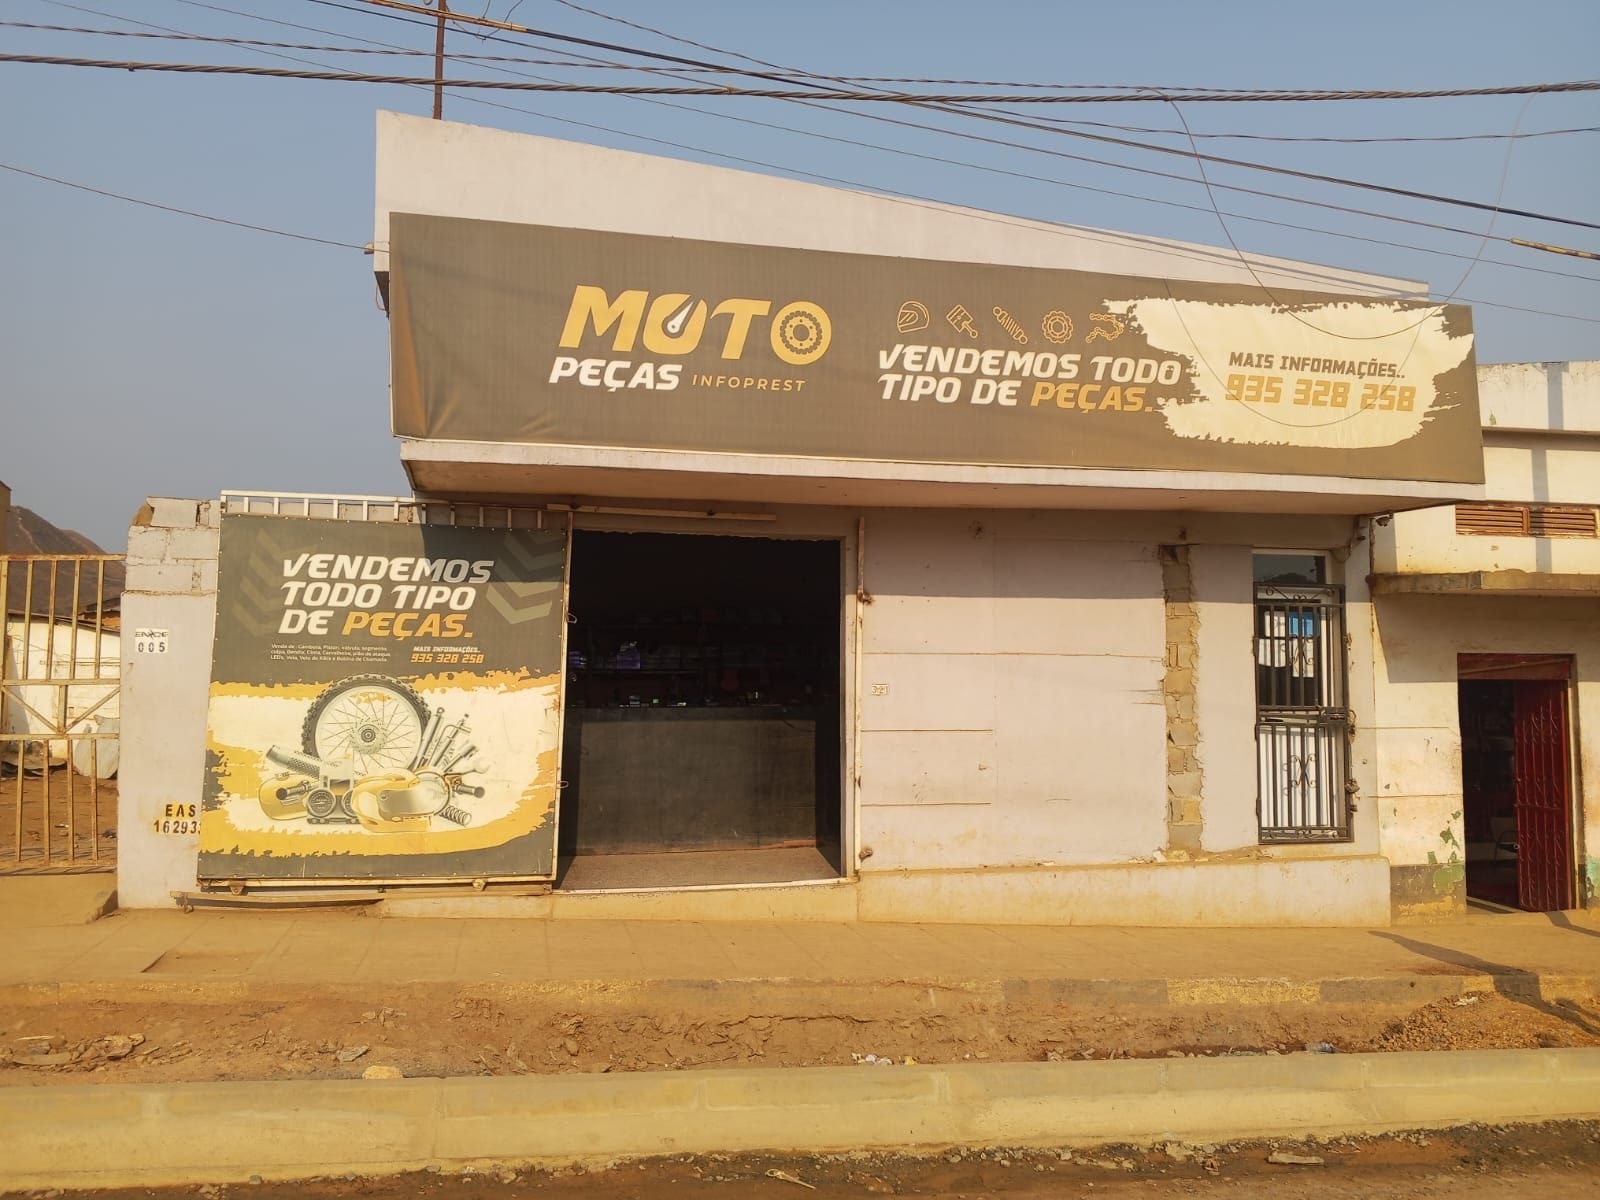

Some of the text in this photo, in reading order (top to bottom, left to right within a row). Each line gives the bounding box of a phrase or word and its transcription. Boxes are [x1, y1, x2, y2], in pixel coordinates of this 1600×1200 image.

[559, 285, 832, 365] MOTO
[549, 356, 683, 392] PEÇAS
[879, 344, 1182, 385] VENDEMOS TODO
[1229, 352, 1405, 379] MAIS INFORMAÇÕES..
[692, 374, 806, 391] INFOPREST
[877, 373, 1153, 414] TIPO DE PEÇAS.
[1225, 374, 1417, 412] 935 328 258
[283, 553, 494, 584] VENDEMOS
[280, 582, 476, 611] TODO TIPO
[278, 609, 473, 641] DE PEÇAS.
[138, 642, 165, 653] 005
[410, 653, 434, 663] 935
[435, 653, 459, 664] 328
[165, 804, 196, 817] EAS
